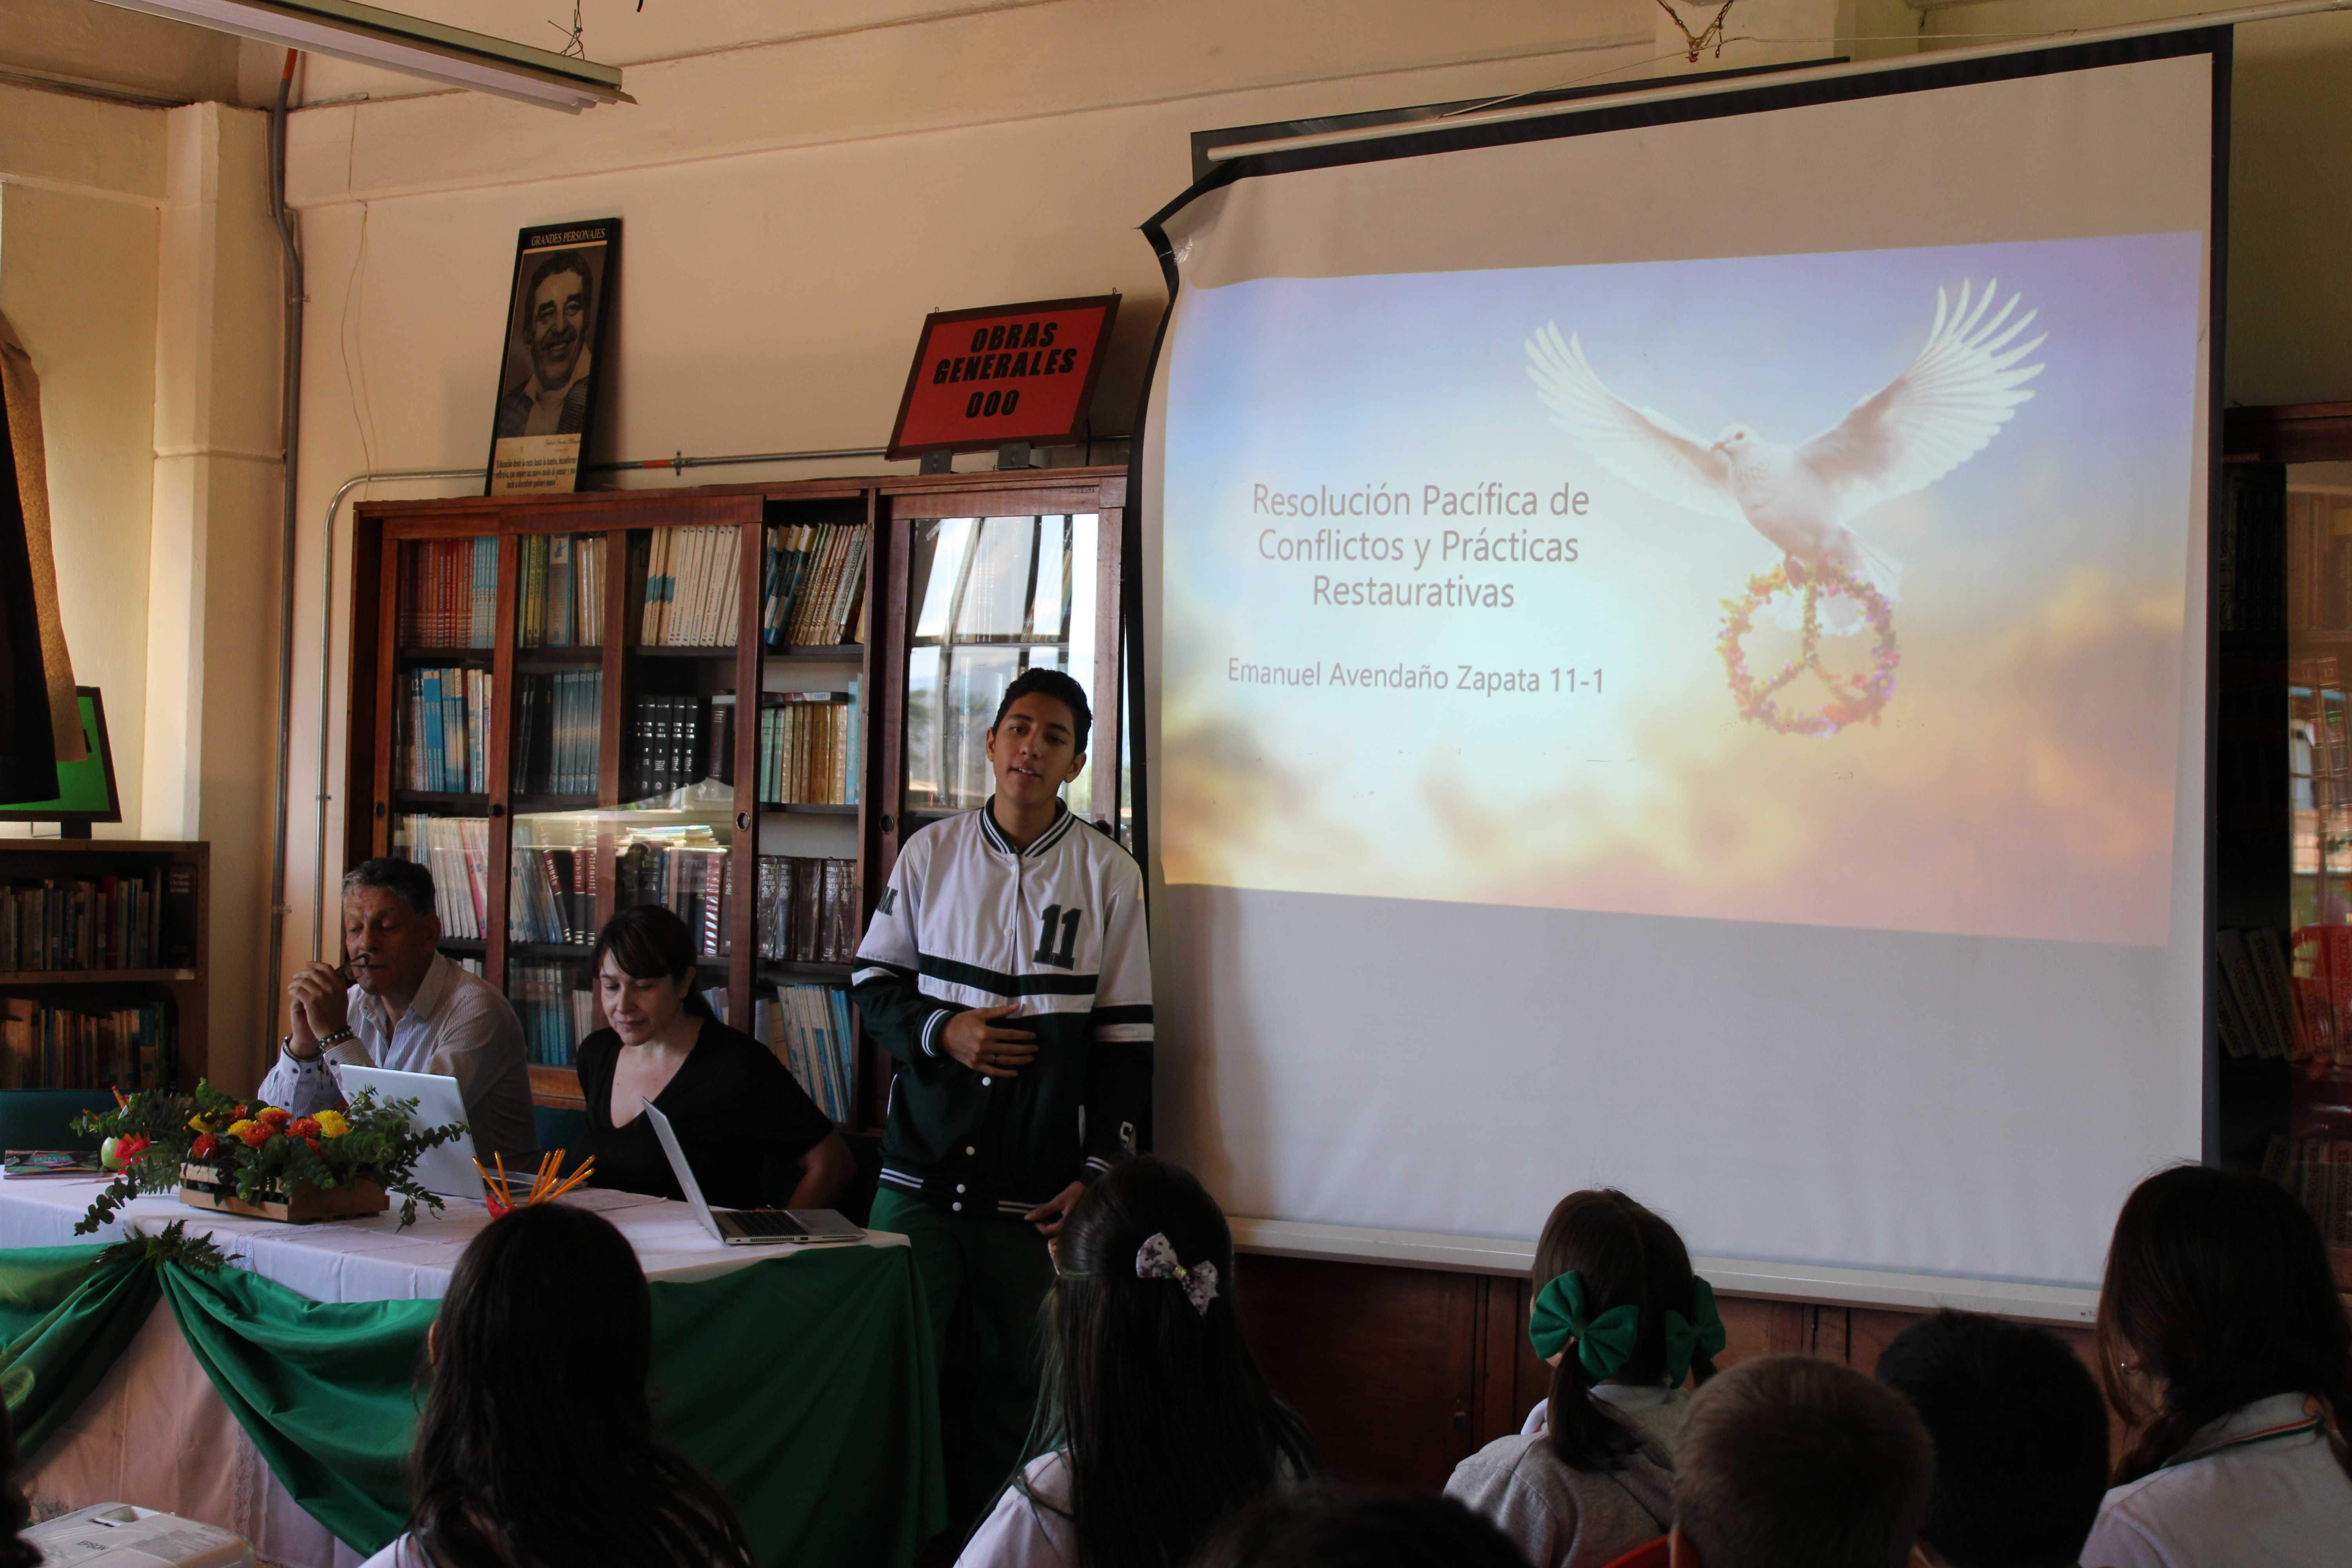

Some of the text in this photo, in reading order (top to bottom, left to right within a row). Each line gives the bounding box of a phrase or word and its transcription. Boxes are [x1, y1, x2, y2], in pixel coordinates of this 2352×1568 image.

[531, 228, 605, 246] GRANDES PERSONAJES
[970, 322, 1057, 353] OBRAS
[933, 348, 1077, 385] GENERALES
[1254, 482, 1589, 517] Resolución Pacífica de
[1259, 528, 1579, 571] Conflictos y Prácticas
[1313, 575, 1514, 608] Restaurativas
[1228, 658, 1603, 698] Emanuel Avendaño Zapata 11-1
[1033, 903, 1082, 971] 11
[77, 1540, 109, 1550] EPSON
